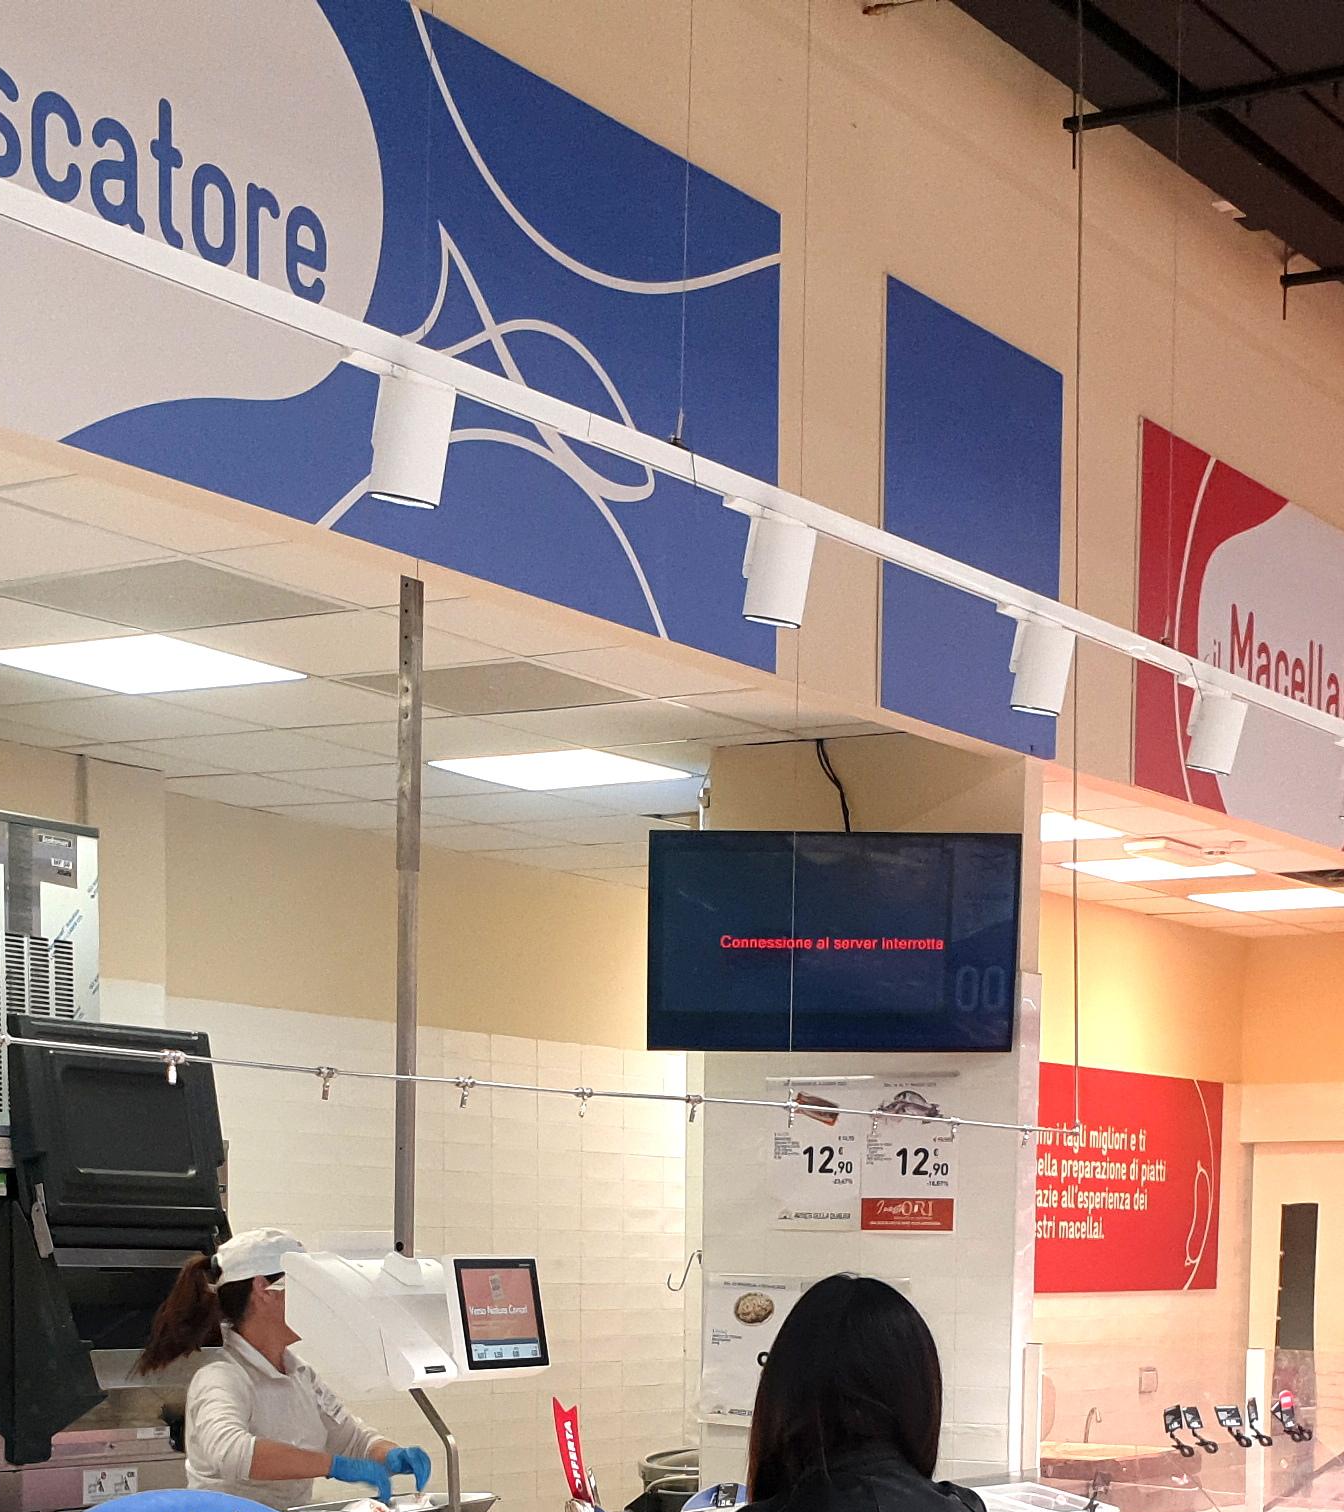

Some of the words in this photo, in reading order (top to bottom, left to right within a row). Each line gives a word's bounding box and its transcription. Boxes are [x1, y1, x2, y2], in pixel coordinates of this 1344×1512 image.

[719, 935, 812, 950] Connessione
[816, 935, 830, 950] al
[833, 939, 878, 950] server
[1090, 1125, 1128, 1156] migliori
[1130, 1136, 1136, 1149] e
[1139, 1130, 1147, 1152] ti
[1036, 1153, 1058, 1177] ella
[1061, 1156, 1127, 1184] preparazione
[1130, 1159, 1139, 1181] di
[1142, 1160, 1167, 1187] piatti
[1134, 1188, 1148, 1210] dei
[564, 1420, 583, 1493] OFFERTA
